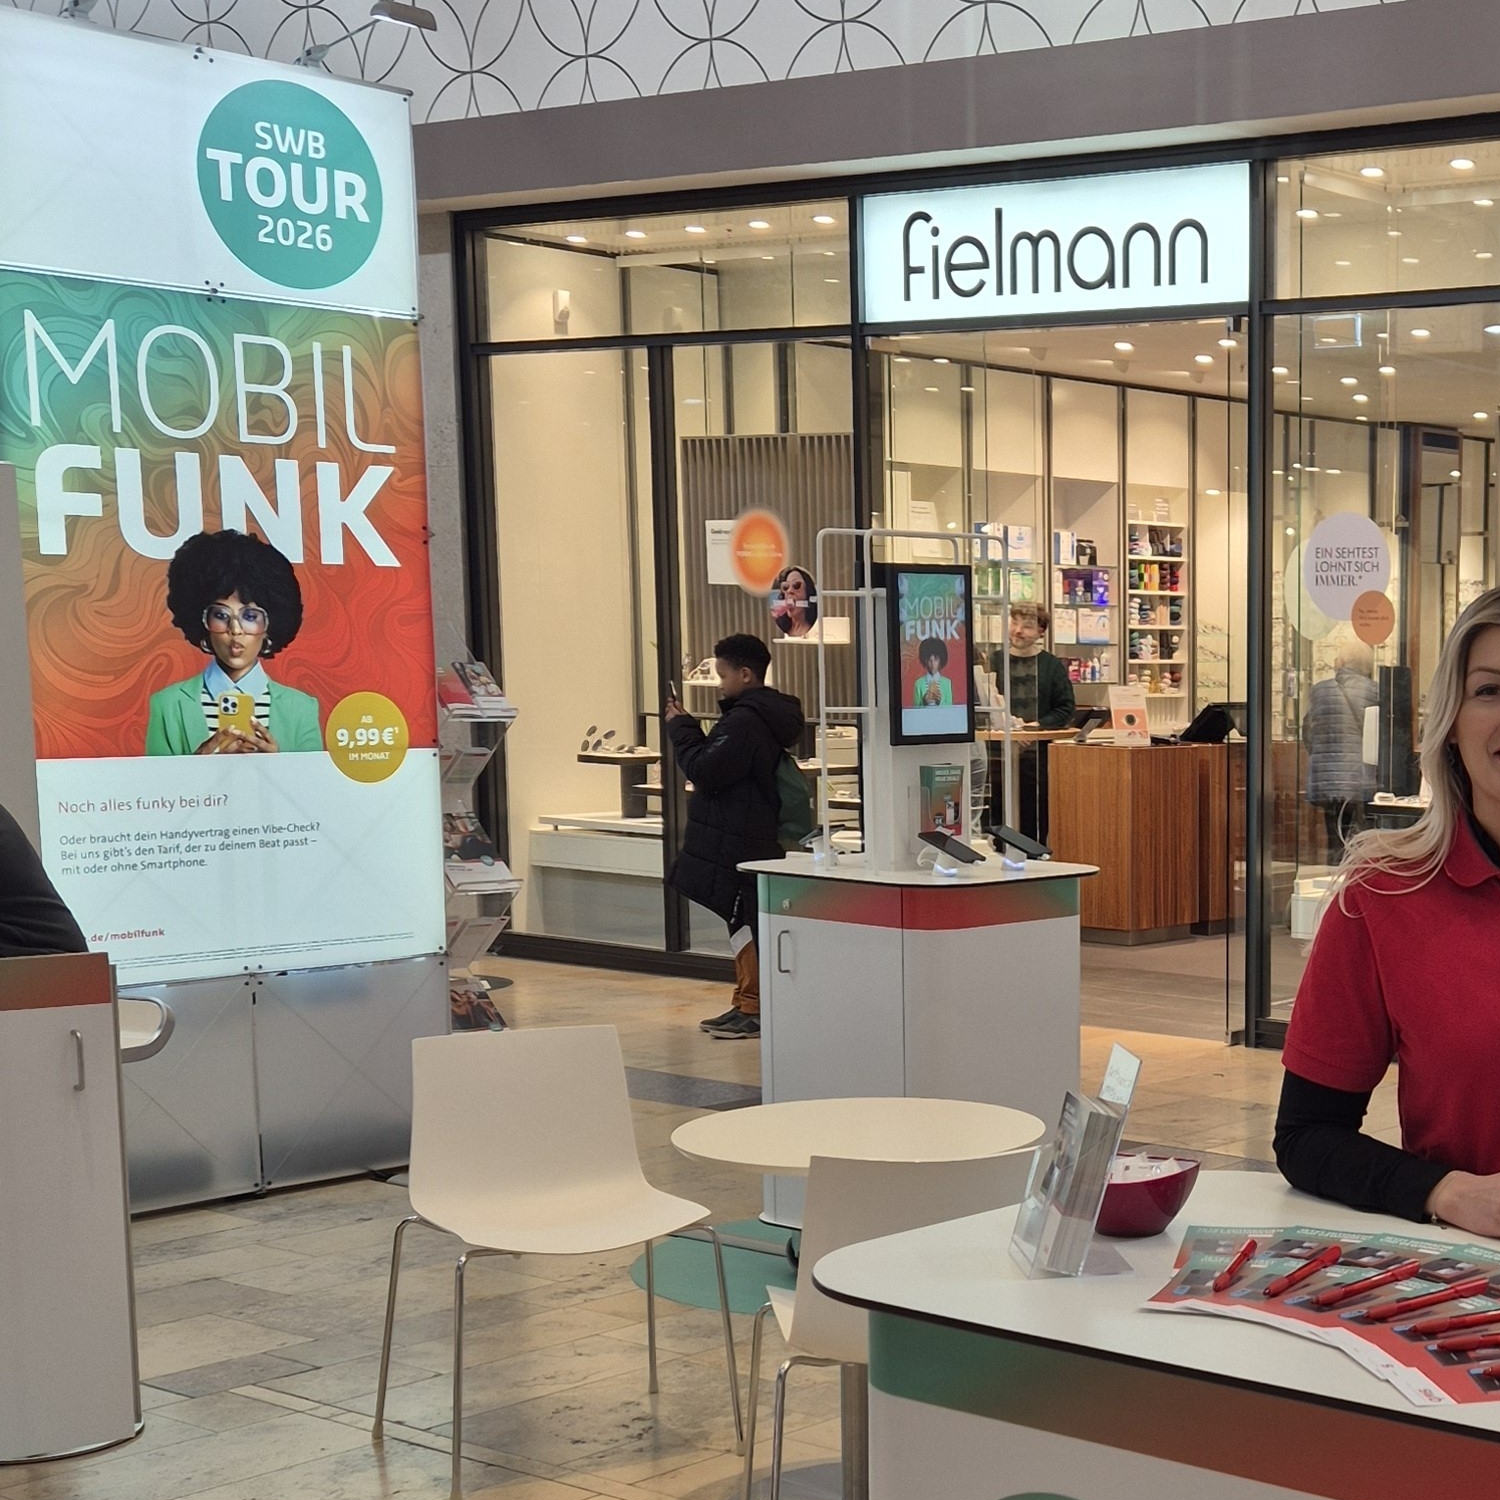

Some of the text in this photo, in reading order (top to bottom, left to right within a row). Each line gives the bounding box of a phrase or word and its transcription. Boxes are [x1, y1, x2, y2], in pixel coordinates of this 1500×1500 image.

[254, 121, 326, 159] SWB
[206, 148, 370, 224] TOUR
[258, 215, 333, 251] 2026
[902, 208, 1208, 301] fielmann
[24, 308, 397, 454] MOBIL
[34, 443, 402, 568] FUNK
[1315, 547, 1379, 559] EIN SEHTEST
[1315, 561, 1380, 573] LOHNT SICH
[904, 595, 959, 620] MOBIL
[904, 619, 961, 641] FUNK
[361, 715, 374, 724] AB
[349, 752, 390, 761] IM MONAT
[58, 794, 229, 814] Noch alles funky bei dir?
[59, 821, 320, 847] Oder braucht dein Handyvertrag einen Vibe-Check?
[60, 850, 78, 861] Bei
[80, 849, 100, 860] uns
[134, 845, 155, 856] den
[157, 843, 183, 856] Tarif,
[184, 842, 202, 854] der
[204, 842, 216, 852] zu
[218, 839, 257, 851] deinem
[258, 838, 281, 849] Beat
[282, 837, 309, 850] passt
[61, 857, 208, 876] mit oder ohne Smartphone.
[85, 927, 165, 943] .de/mobilfunk
